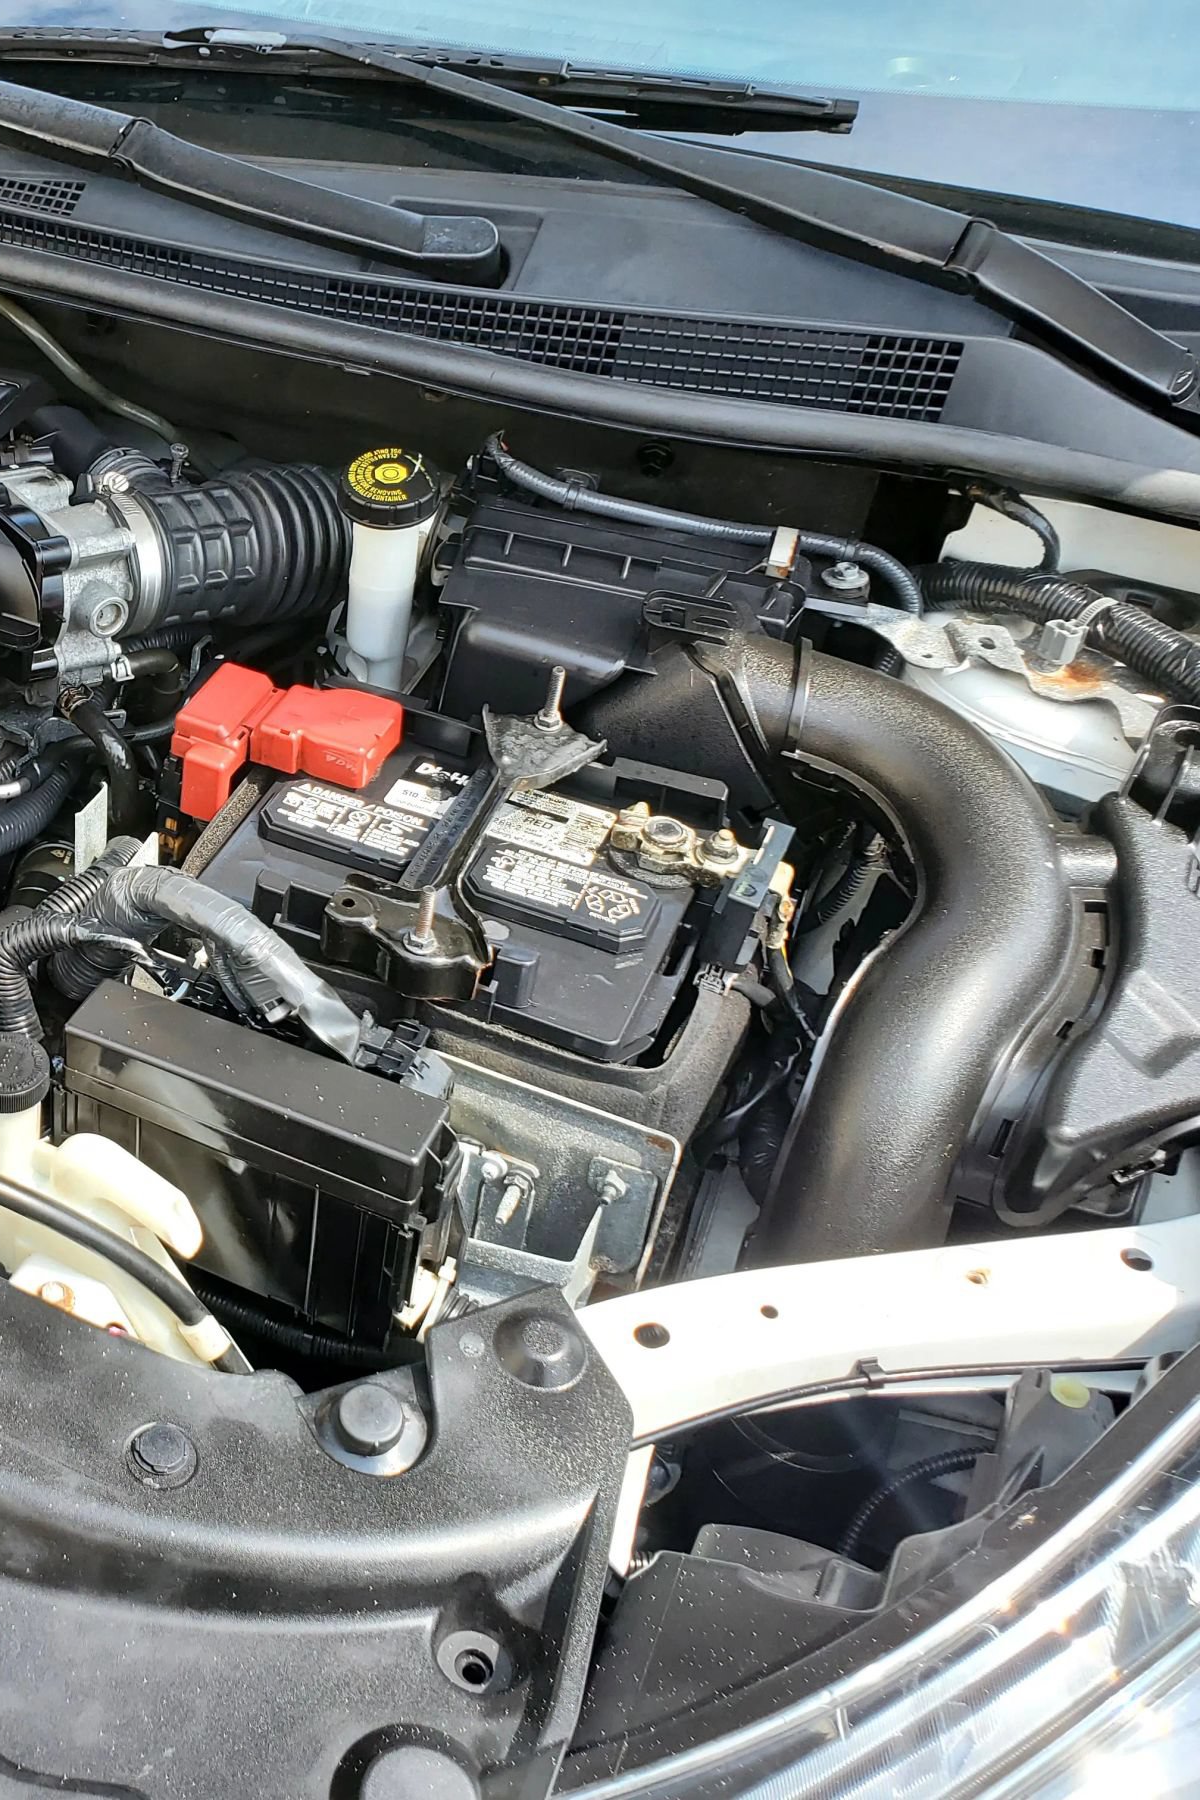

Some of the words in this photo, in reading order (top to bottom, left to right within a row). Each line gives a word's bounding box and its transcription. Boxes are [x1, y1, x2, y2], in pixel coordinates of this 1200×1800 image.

[371, 494, 408, 502] CONTAINER
[311, 783, 365, 807] DANGER
[374, 805, 425, 826] POISON
[523, 816, 554, 830] RED
